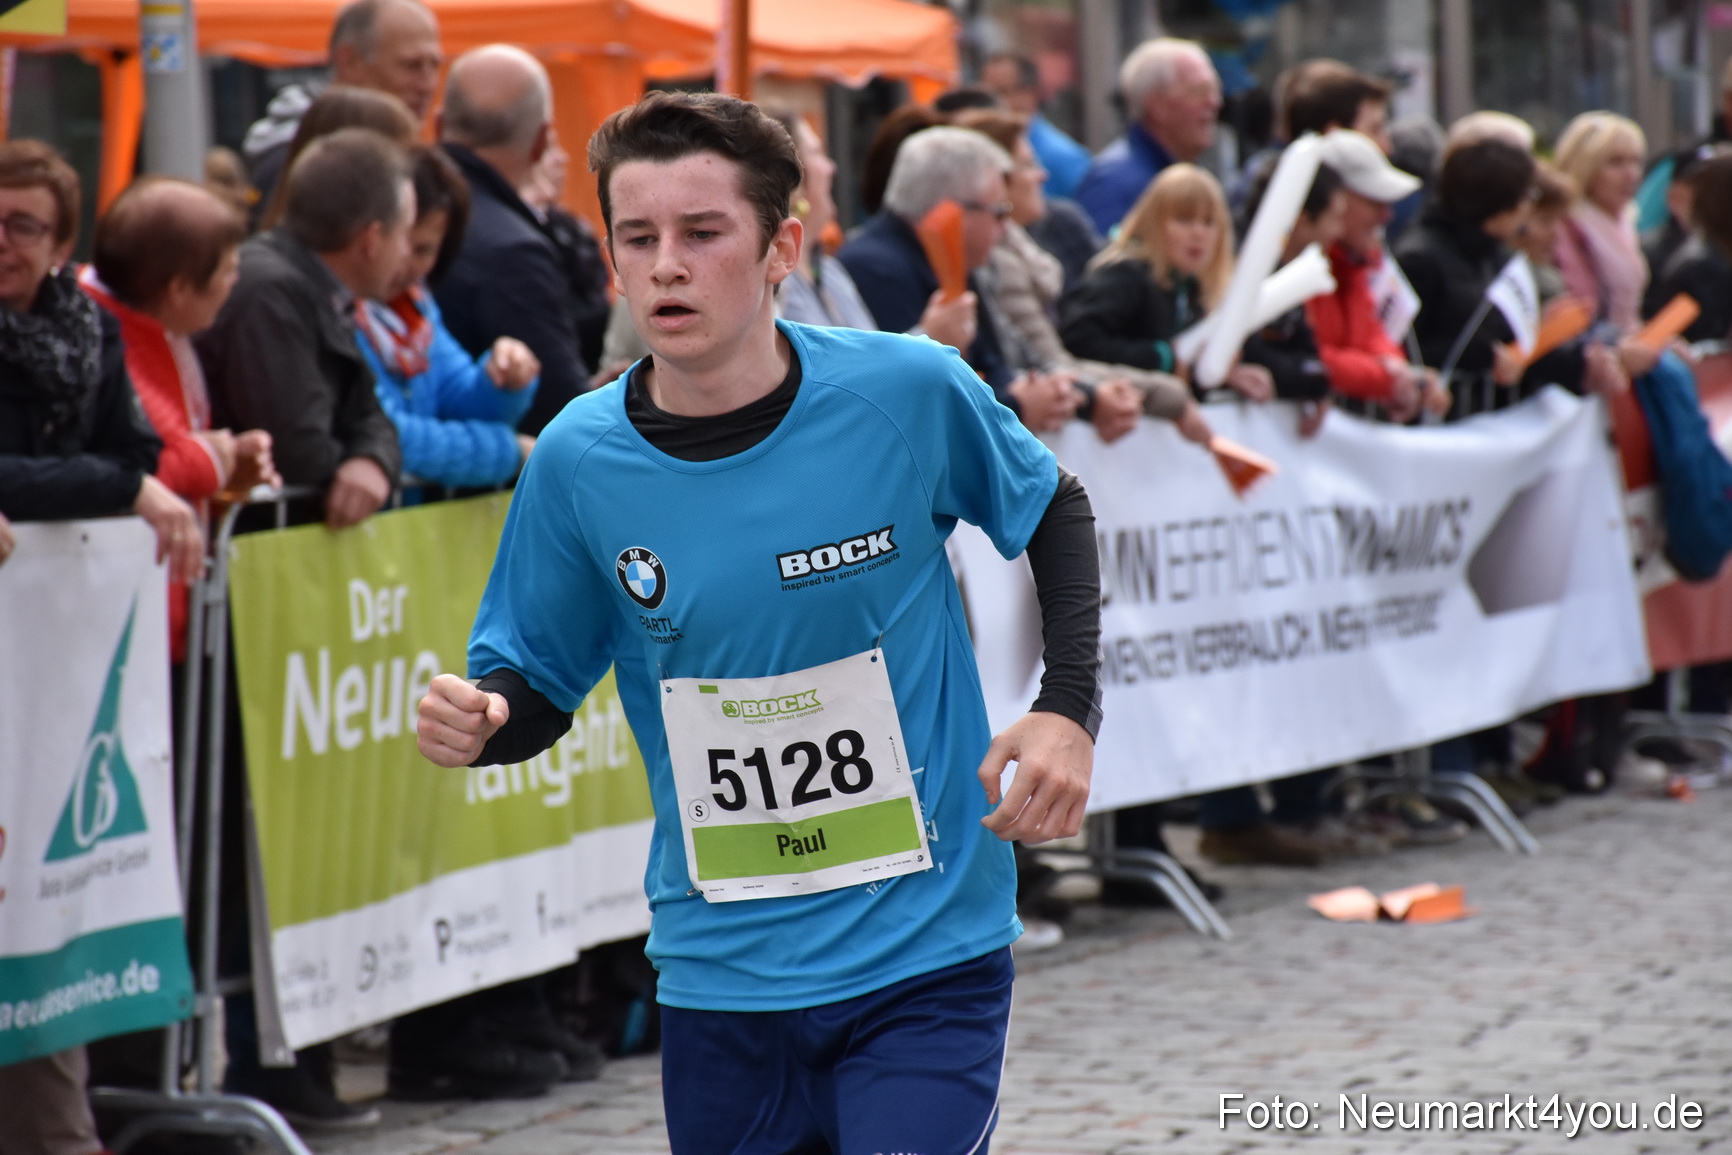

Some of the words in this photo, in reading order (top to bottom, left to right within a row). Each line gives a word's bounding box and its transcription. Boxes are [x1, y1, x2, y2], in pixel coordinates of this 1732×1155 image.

[618, 549, 660, 572] BMW
[777, 525, 897, 581] BOCK
[781, 578, 822, 592] inspired
[823, 574, 836, 584] by
[838, 567, 866, 580] smart
[867, 552, 900, 572] concepts
[348, 577, 408, 643] Der
[639, 615, 679, 632] PARTL
[281, 646, 442, 761] Neue
[741, 688, 822, 718] BOCK
[744, 717, 767, 725] inspired
[777, 714, 795, 722] smart
[796, 706, 825, 718] concepts
[707, 729, 874, 812] 5128
[694, 805, 704, 818] S
[776, 828, 827, 857] Paul
